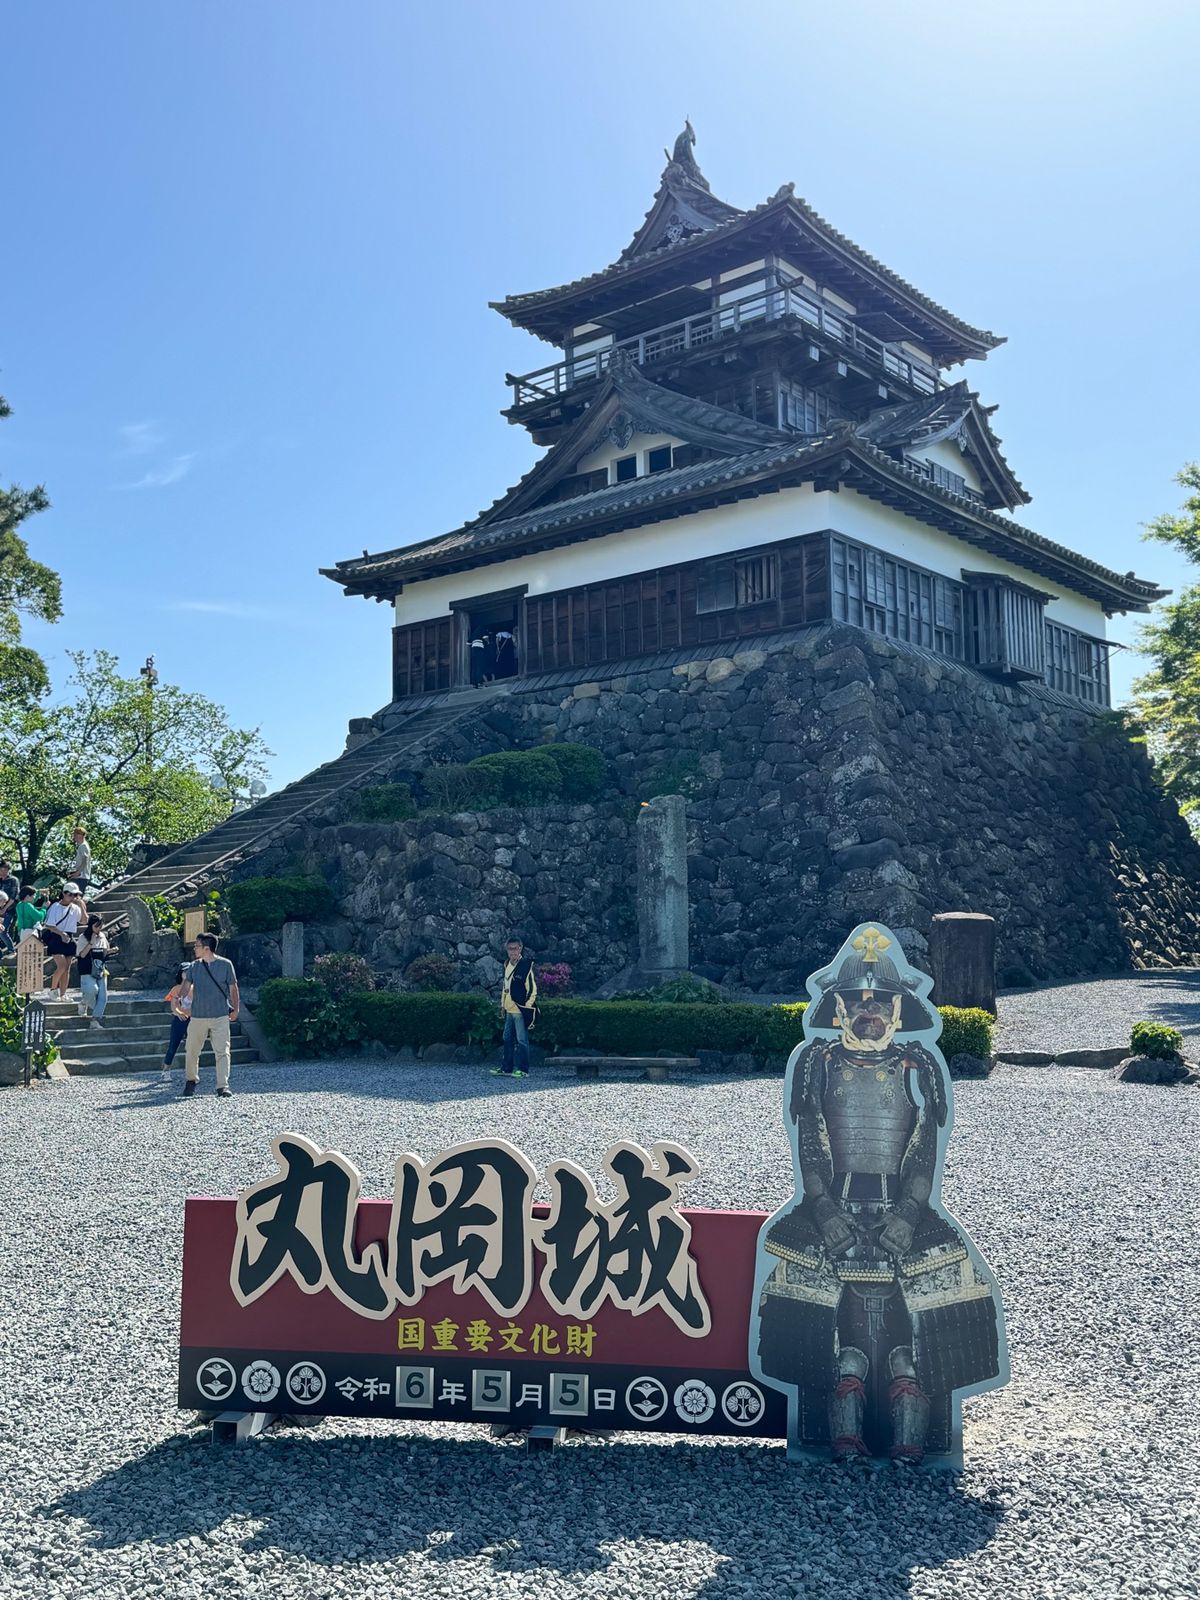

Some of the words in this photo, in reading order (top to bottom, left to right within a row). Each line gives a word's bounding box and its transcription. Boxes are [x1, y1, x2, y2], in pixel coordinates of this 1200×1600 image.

[237, 1141, 706, 1330] 丸岡城
[397, 1317, 597, 1358] 国重要文化財
[335, 1371, 616, 1411] 令和6年5月5日
